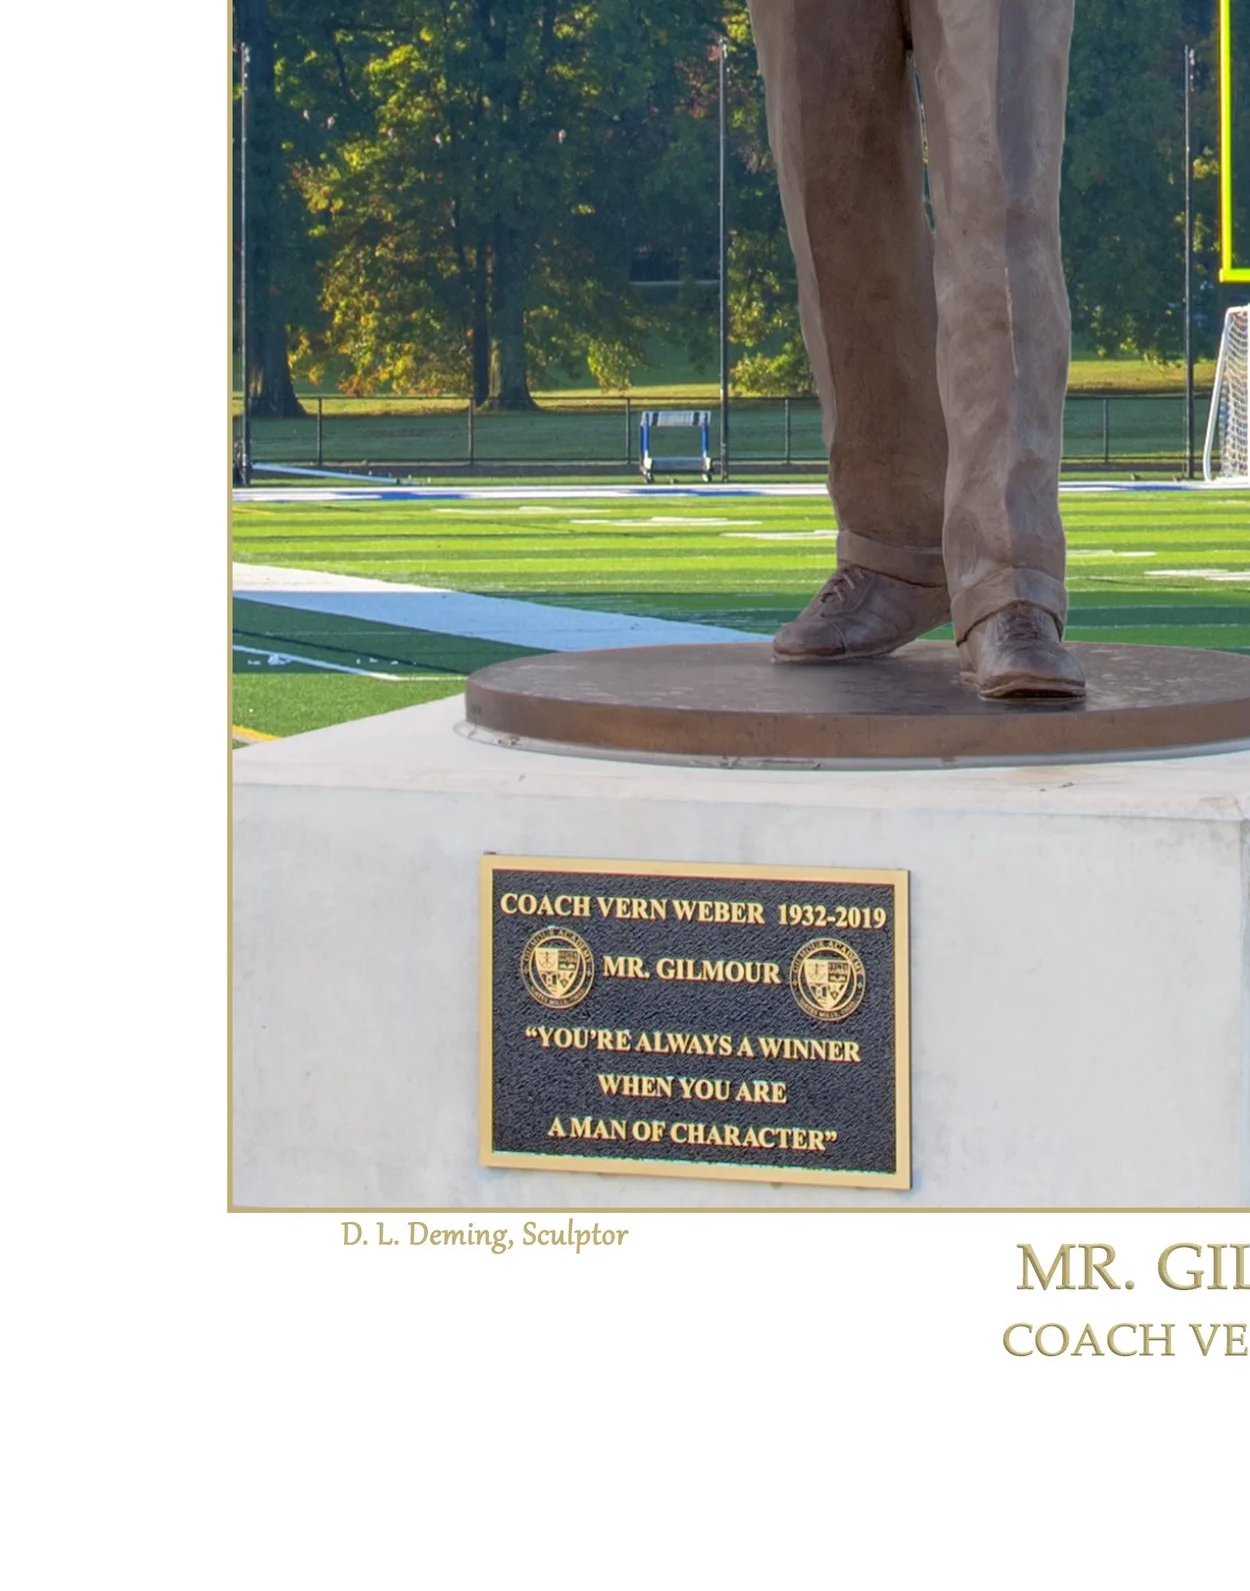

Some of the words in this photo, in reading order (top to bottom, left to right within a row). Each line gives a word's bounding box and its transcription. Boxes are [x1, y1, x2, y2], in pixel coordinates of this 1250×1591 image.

[500, 893, 591, 918] COACH
[597, 896, 668, 922] VERN
[672, 899, 766, 926] WEBER
[778, 903, 887, 929] 1932-2019
[602, 955, 651, 980] MR.
[656, 958, 782, 985] GILMOUR
[637, 1030, 733, 1057] ALWAYS
[736, 1037, 755, 1058] A
[758, 1037, 862, 1064] WINNER
[598, 1073, 674, 1099] WHEN
[678, 1076, 732, 1102] YOU
[735, 1079, 788, 1105] ARE
[547, 1118, 567, 1139] A
[570, 1116, 628, 1141] MAN
[632, 1120, 666, 1144] OF
[669, 1122, 838, 1152] CHARACTER”
